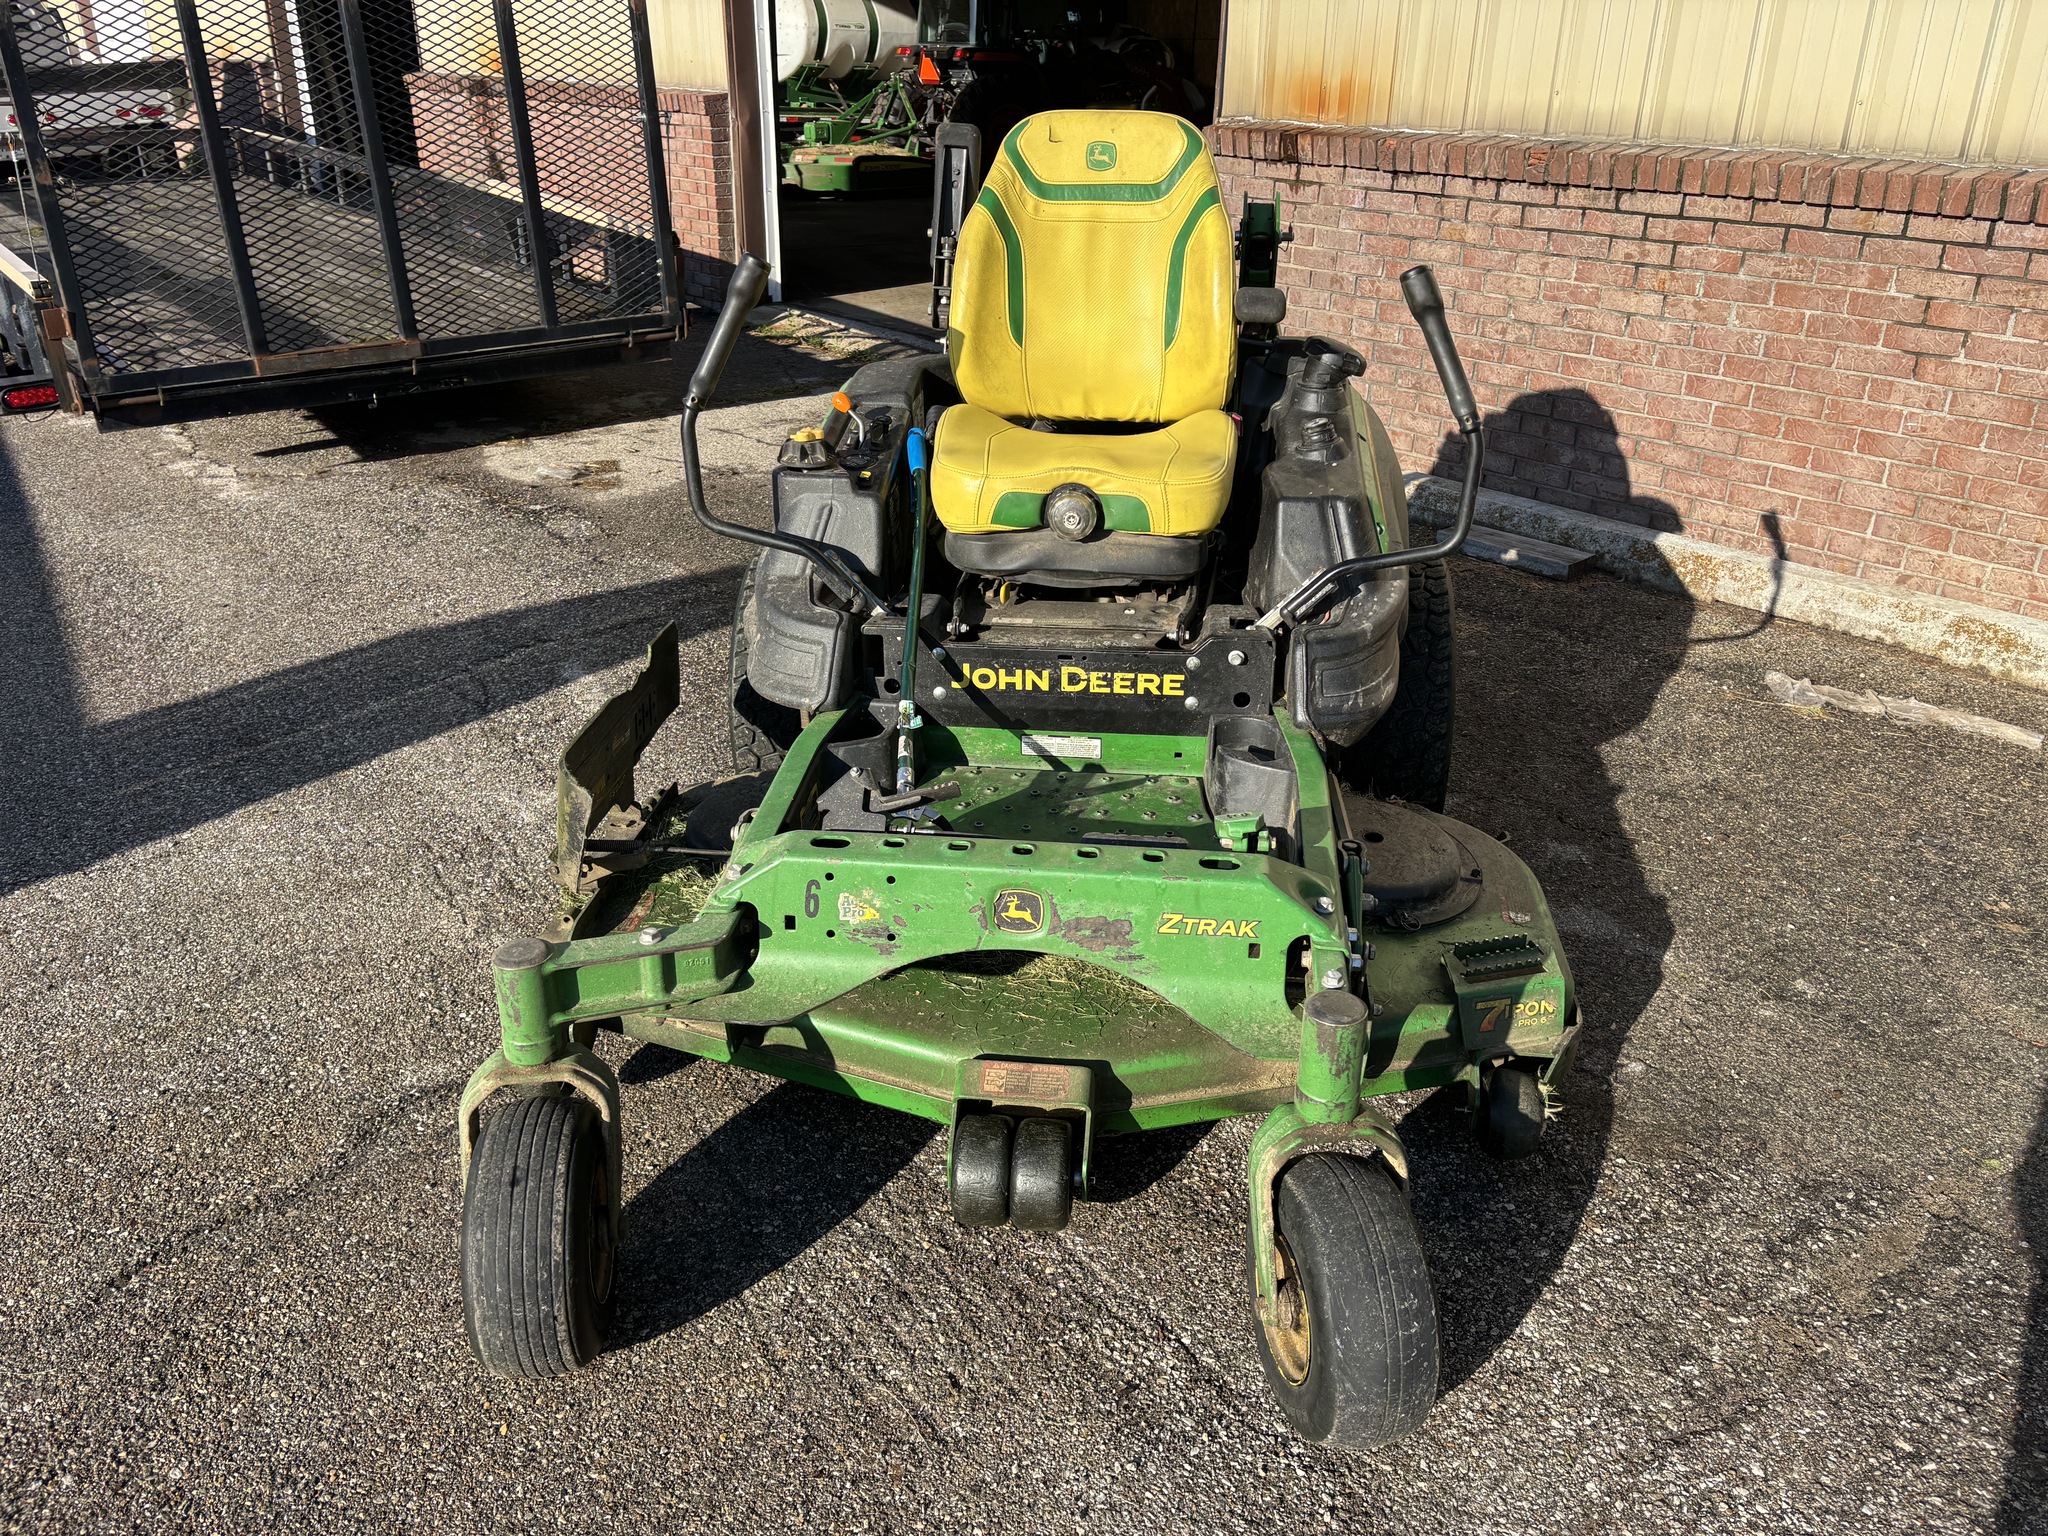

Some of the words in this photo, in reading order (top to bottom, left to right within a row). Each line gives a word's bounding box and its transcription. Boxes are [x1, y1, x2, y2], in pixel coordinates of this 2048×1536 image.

[951, 663, 1049, 691] JOHN
[1061, 666, 1185, 696] DEERE
[804, 879, 821, 918] 6
[842, 907, 865, 917] Pro
[1157, 913, 1261, 938] ZTRAK
[1476, 998, 1511, 1031] 7
[1518, 1018, 1538, 1027] PRO
